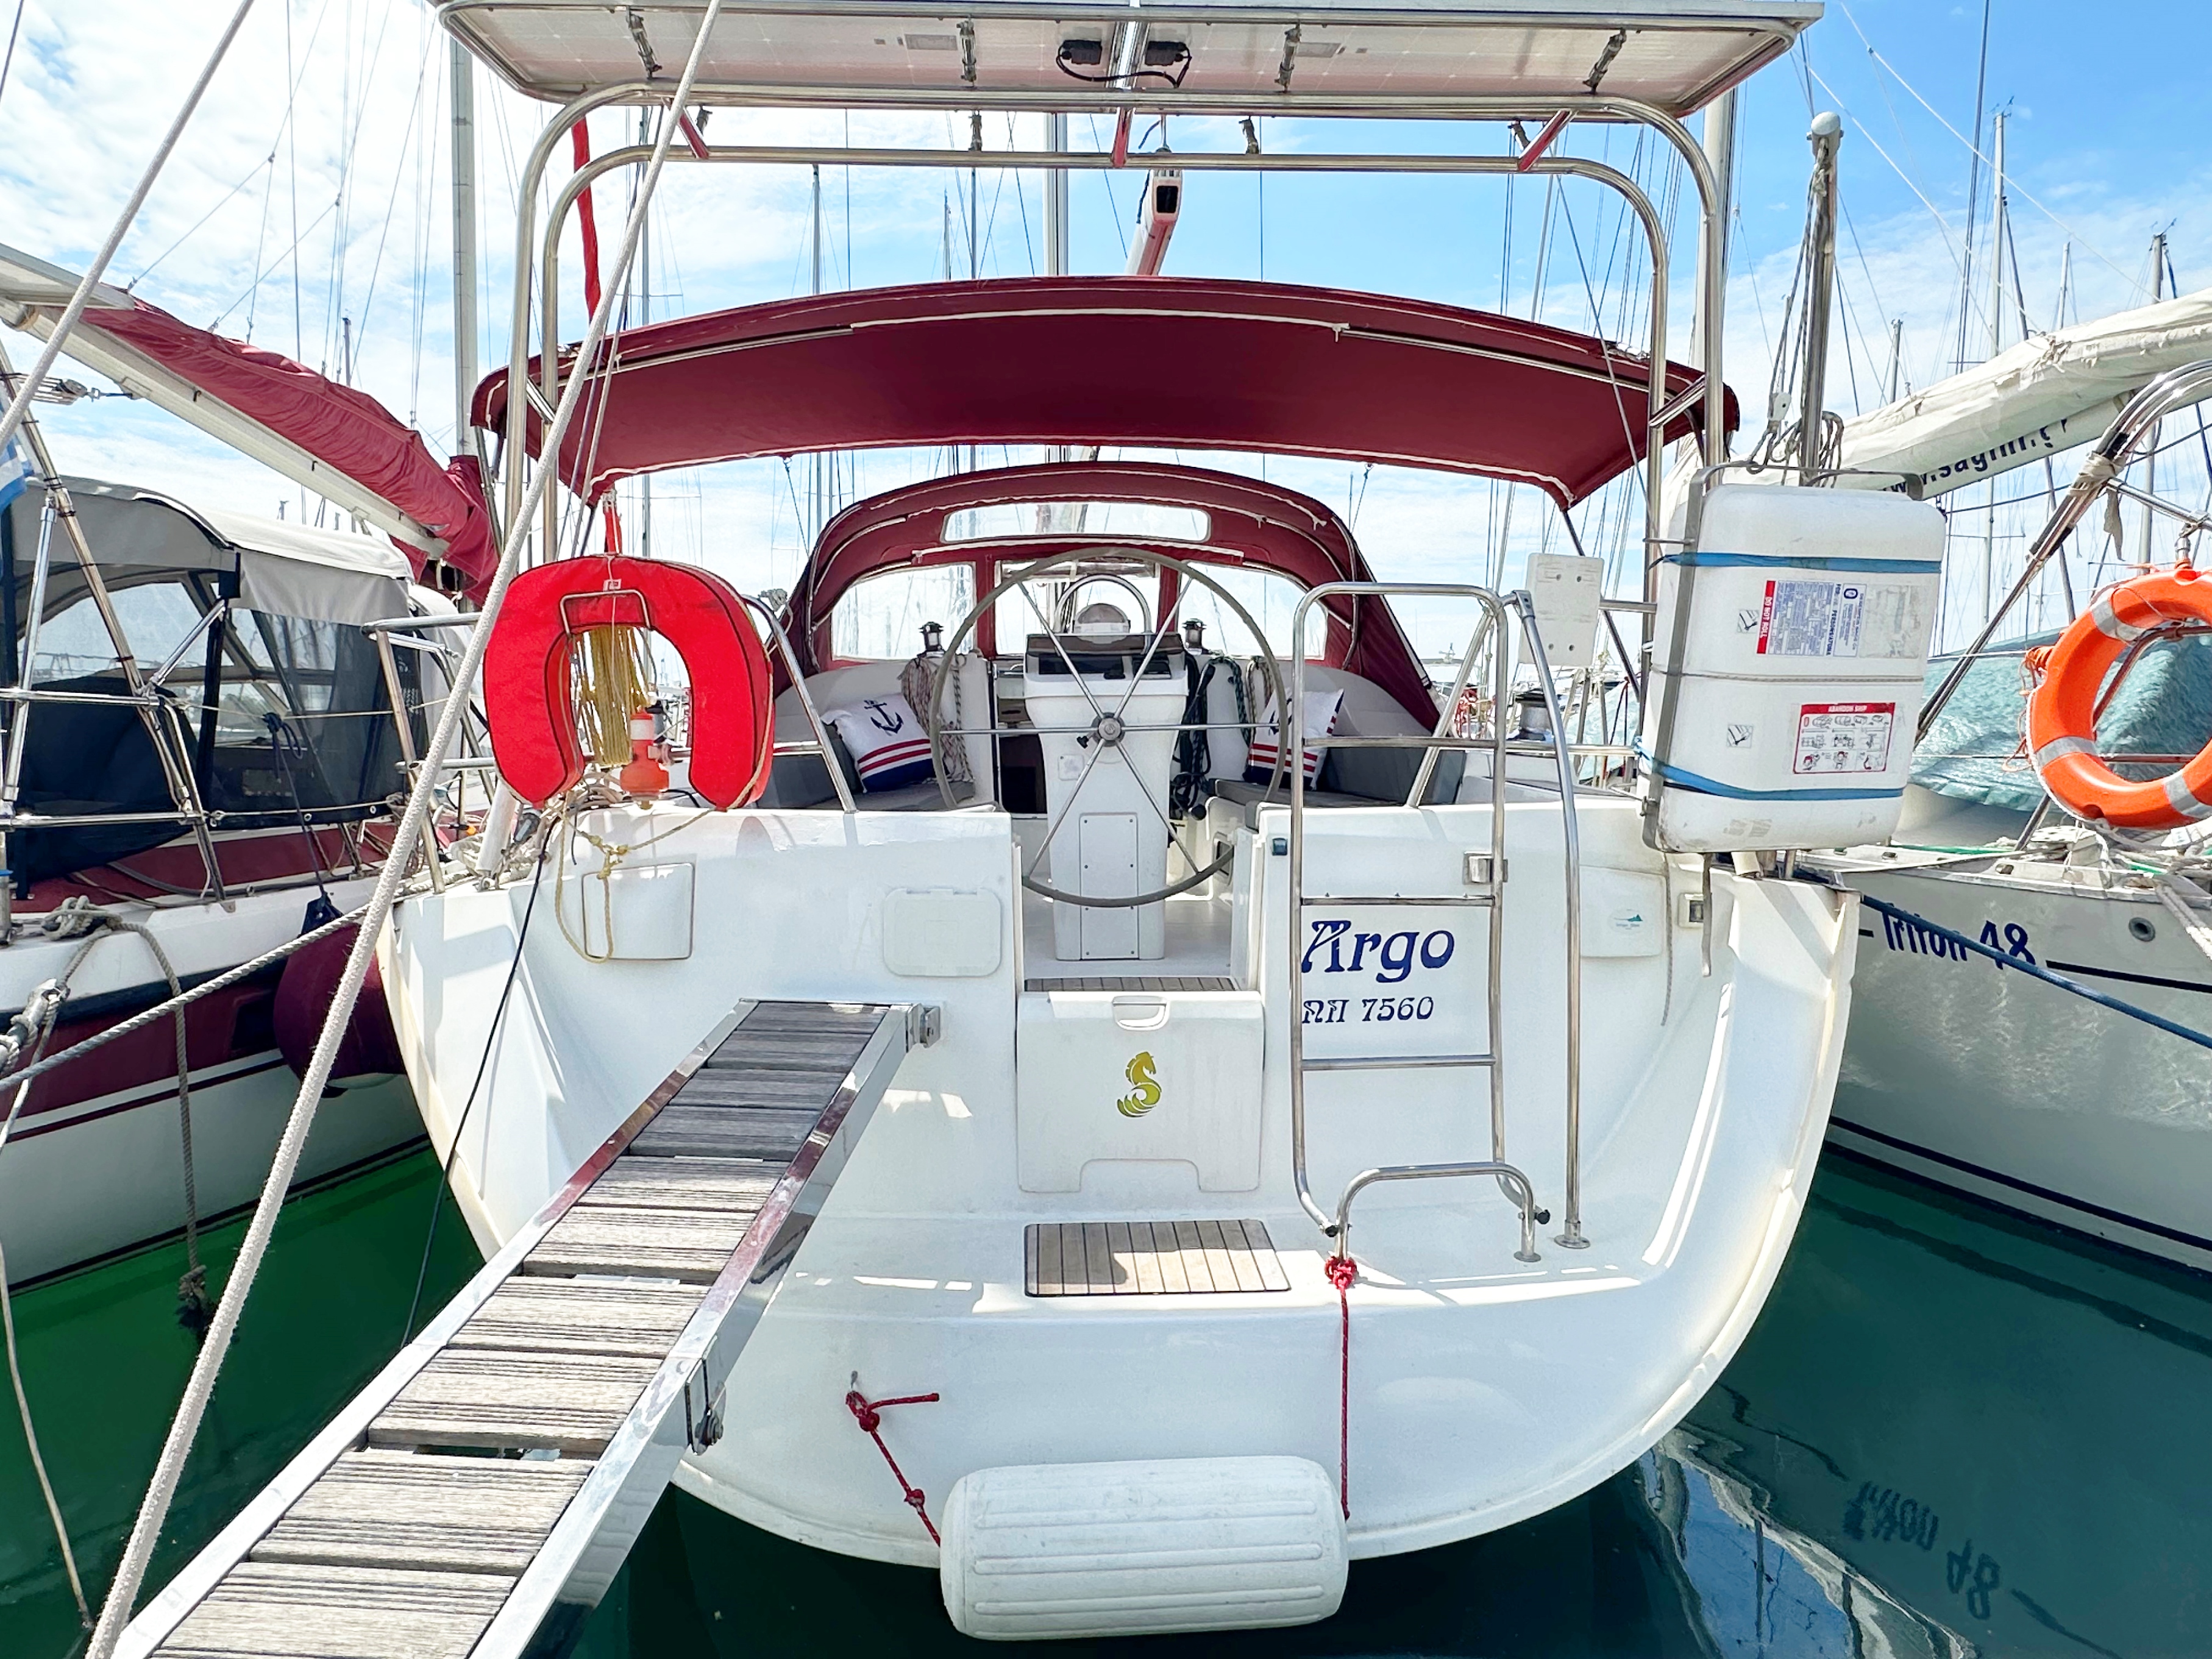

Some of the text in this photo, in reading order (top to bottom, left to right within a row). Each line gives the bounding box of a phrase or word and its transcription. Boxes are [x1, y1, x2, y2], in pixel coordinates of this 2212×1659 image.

[1759, 597, 1773, 639] DO NOT ROLL
[1301, 920, 1455, 983] Argo
[1980, 920, 2036, 970] 48
[1362, 996, 1434, 1022] 7560
